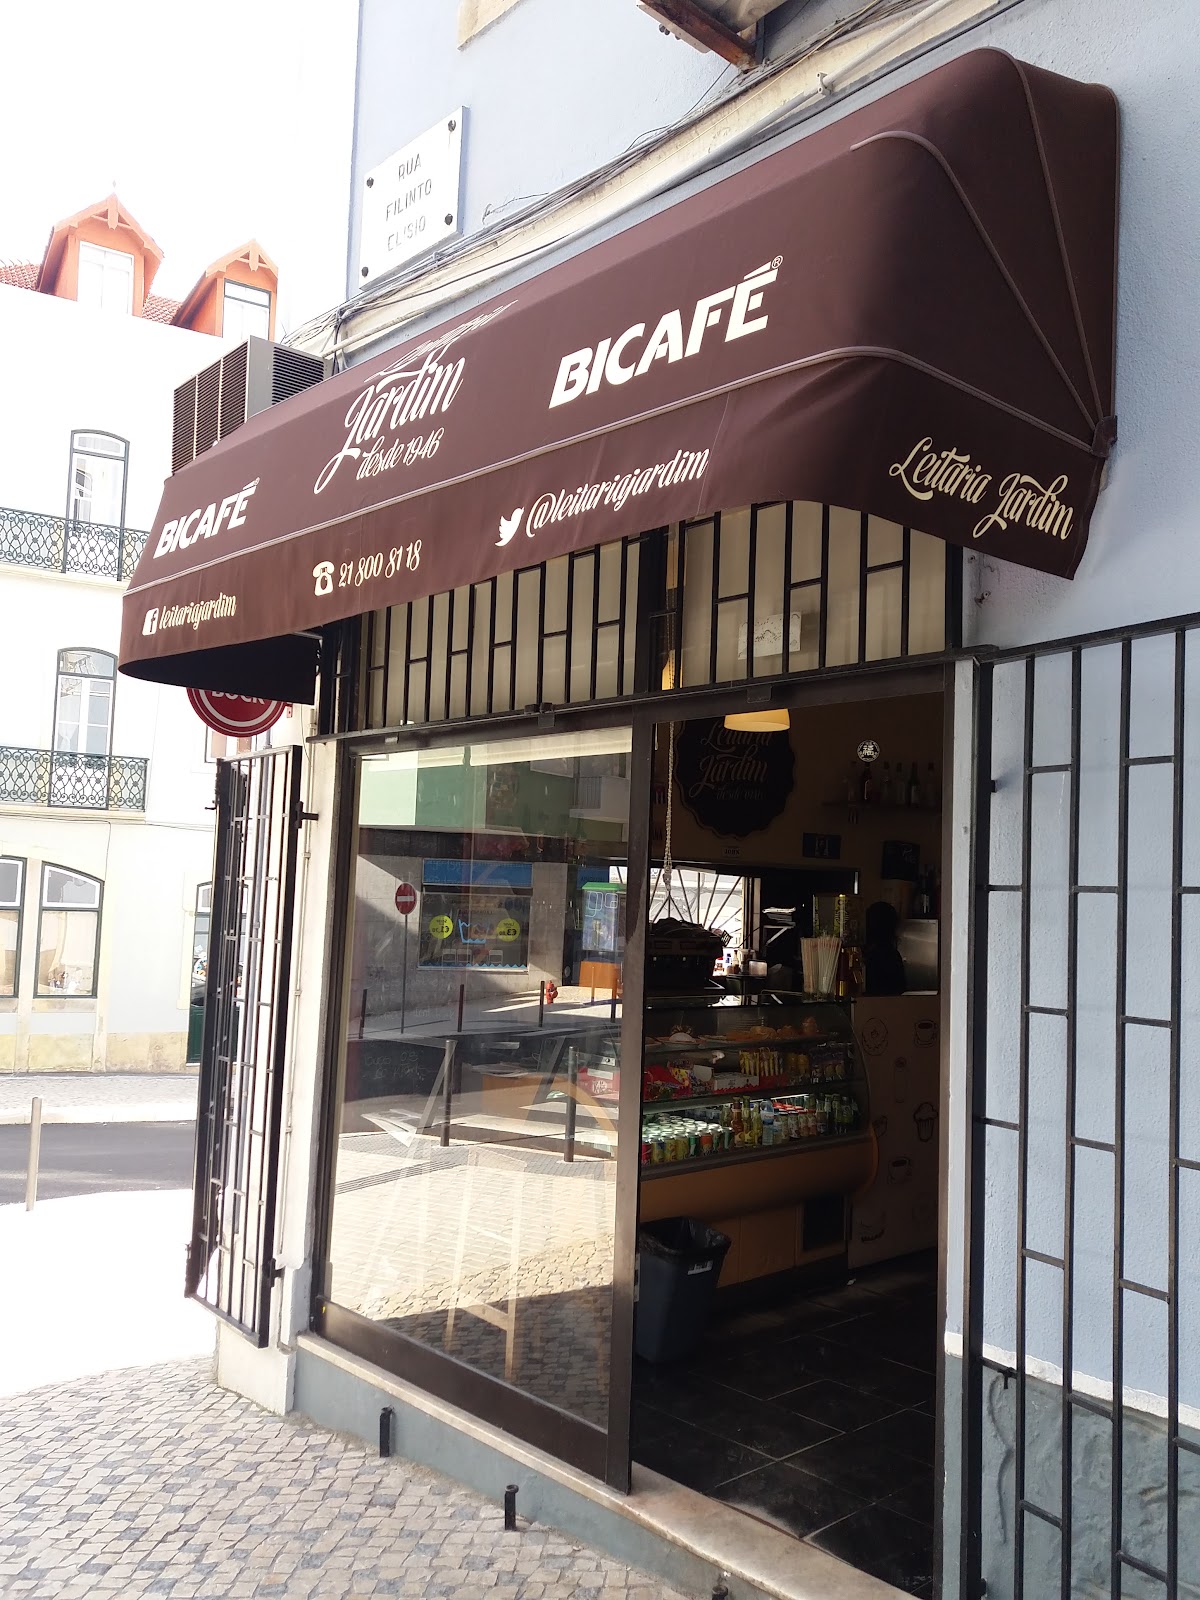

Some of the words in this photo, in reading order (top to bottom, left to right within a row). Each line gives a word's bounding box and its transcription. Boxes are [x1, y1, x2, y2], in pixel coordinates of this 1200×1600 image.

[398, 153, 422, 182] RUA
[386, 178, 432, 222] FILINTO
[549, 260, 779, 409] BICAFÉ
[313, 337, 466, 494] Jardim
[356, 436, 404, 480] desde
[403, 427, 445, 466] 1946
[889, 436, 993, 504] Leitaria
[972, 472, 1074, 540] Jardim
[153, 479, 257, 559] BICAFÉ
[338, 561, 354, 587] 21
[354, 552, 384, 587] 800
[385, 545, 404, 578] 81
[406, 539, 422, 571] 18
[689, 744, 769, 798] Jardim
